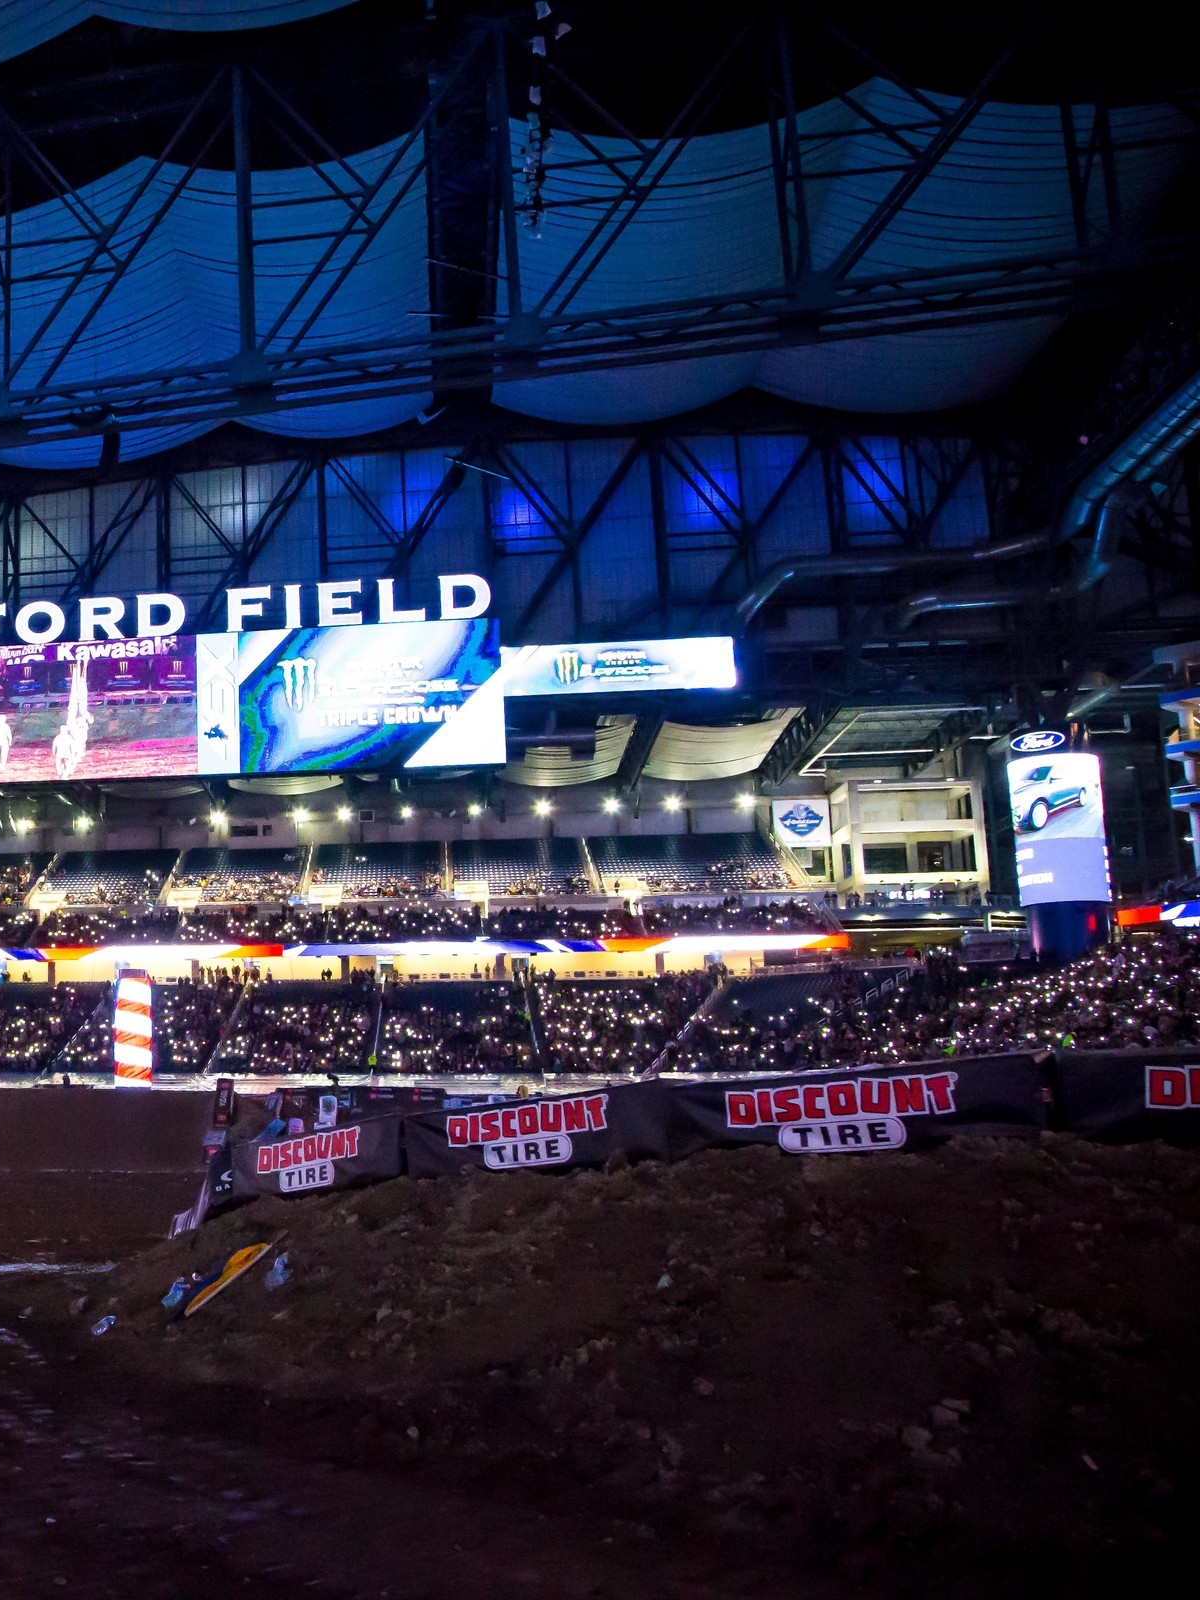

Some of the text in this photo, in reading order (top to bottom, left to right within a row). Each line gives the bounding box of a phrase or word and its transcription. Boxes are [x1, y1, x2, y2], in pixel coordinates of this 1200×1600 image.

[226, 574, 492, 632] FIELD
[318, 705, 458, 727] TRIPLE CROWN
[1020, 733, 1055, 750] Ford
[725, 1071, 959, 1128] DISCOUNT
[447, 1094, 608, 1147] DISCOUNT
[793, 1121, 891, 1147] TIRE
[257, 1126, 360, 1174] DISCOUNT
[491, 1139, 560, 1164] TIRE
[285, 1164, 328, 1187] TIRE
